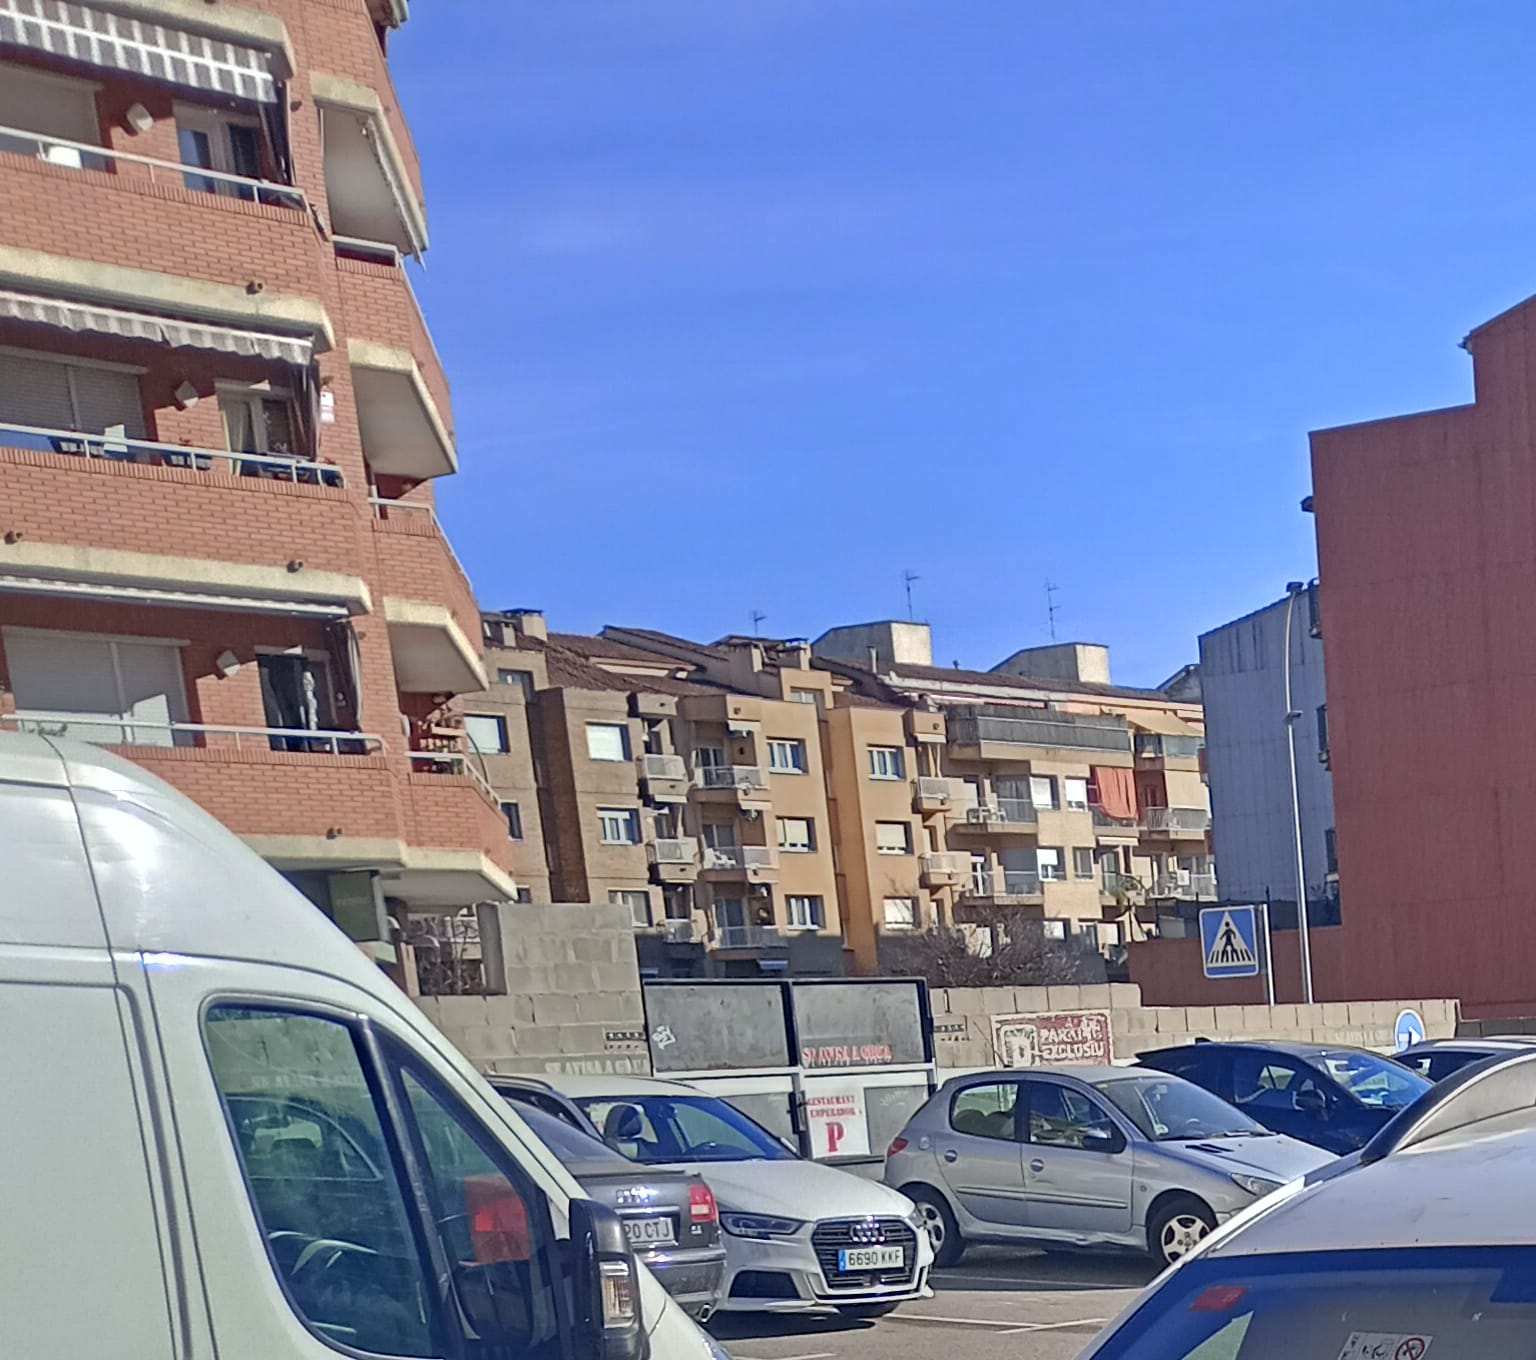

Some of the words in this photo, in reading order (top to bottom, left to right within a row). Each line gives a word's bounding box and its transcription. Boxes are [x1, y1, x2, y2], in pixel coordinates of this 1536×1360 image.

[825, 1122, 844, 1152] P
[644, 1221, 670, 1238] CTJ
[848, 1252, 878, 1266] 6690
